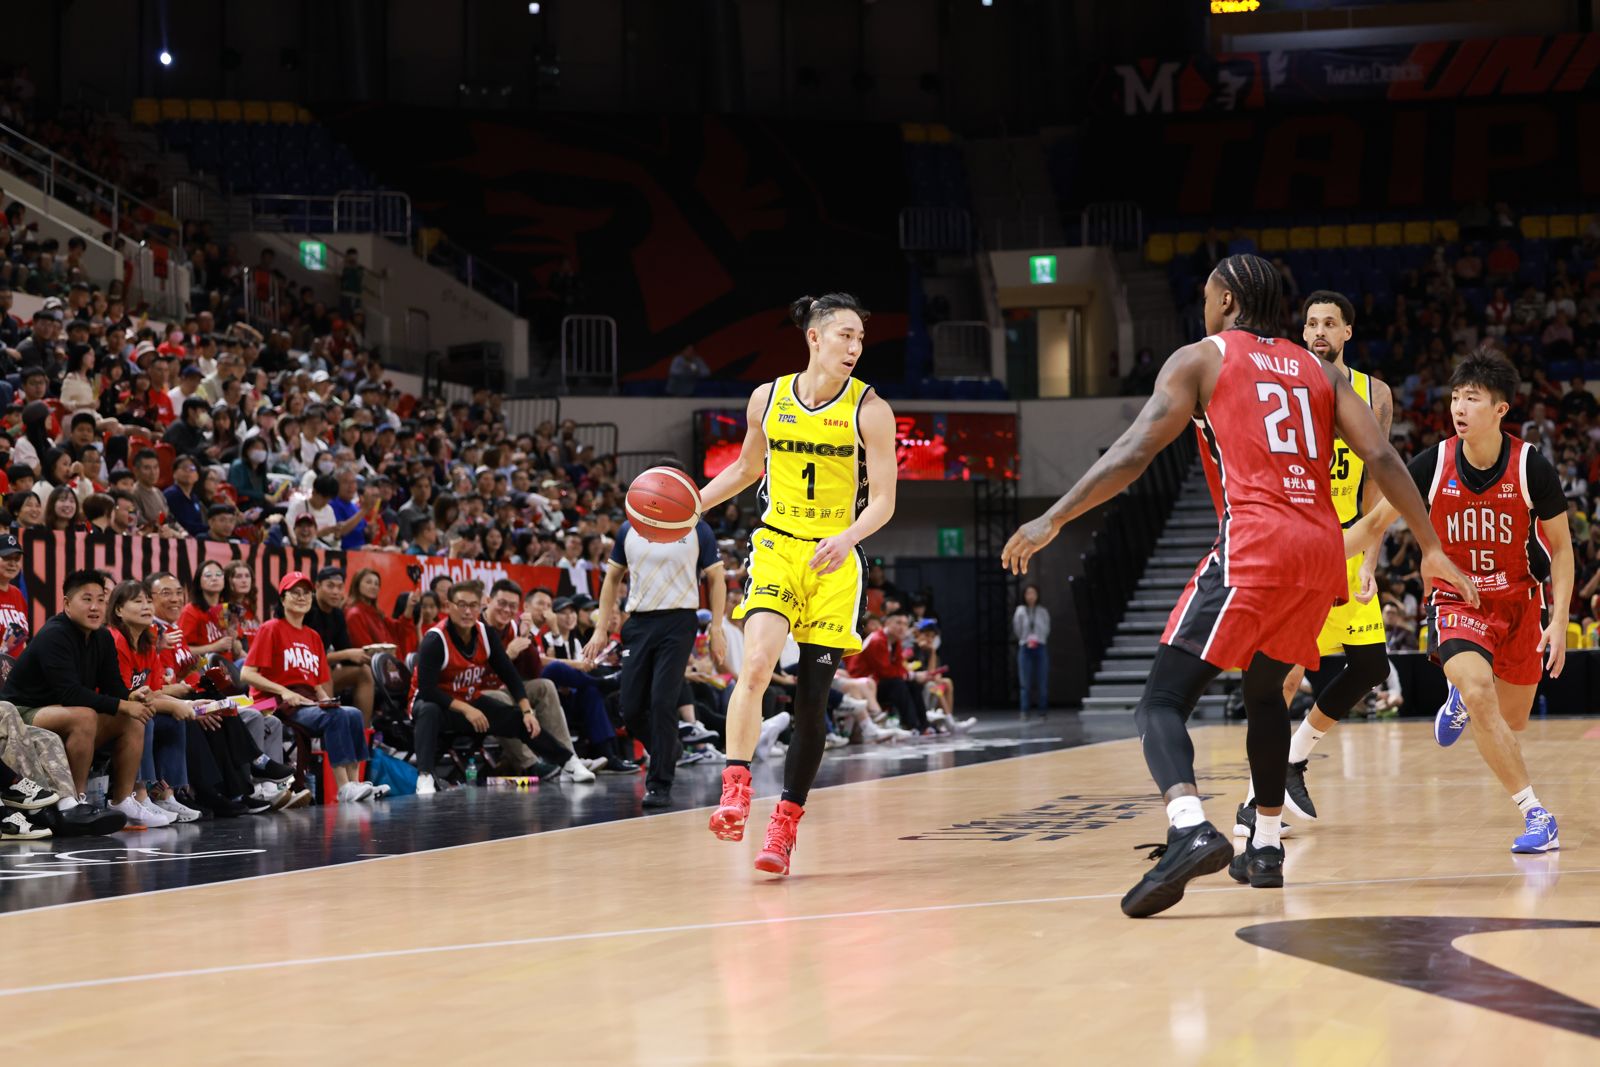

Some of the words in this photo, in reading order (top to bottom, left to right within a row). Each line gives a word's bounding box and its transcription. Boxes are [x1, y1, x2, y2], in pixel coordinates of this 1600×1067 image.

[1165, 103, 1600, 214] TAIP
[1248, 353, 1299, 376] WILLIS
[823, 418, 849, 428] SAMPO
[1256, 381, 1318, 460] 21
[769, 438, 855, 458] KINGS
[801, 462, 816, 501] 1
[790, 506, 846, 519] 王道銀行
[1446, 507, 1513, 544] MARS
[1469, 549, 1495, 572] 15
[1467, 571, 1508, 589] 光三越
[283, 647, 319, 677] MARS
